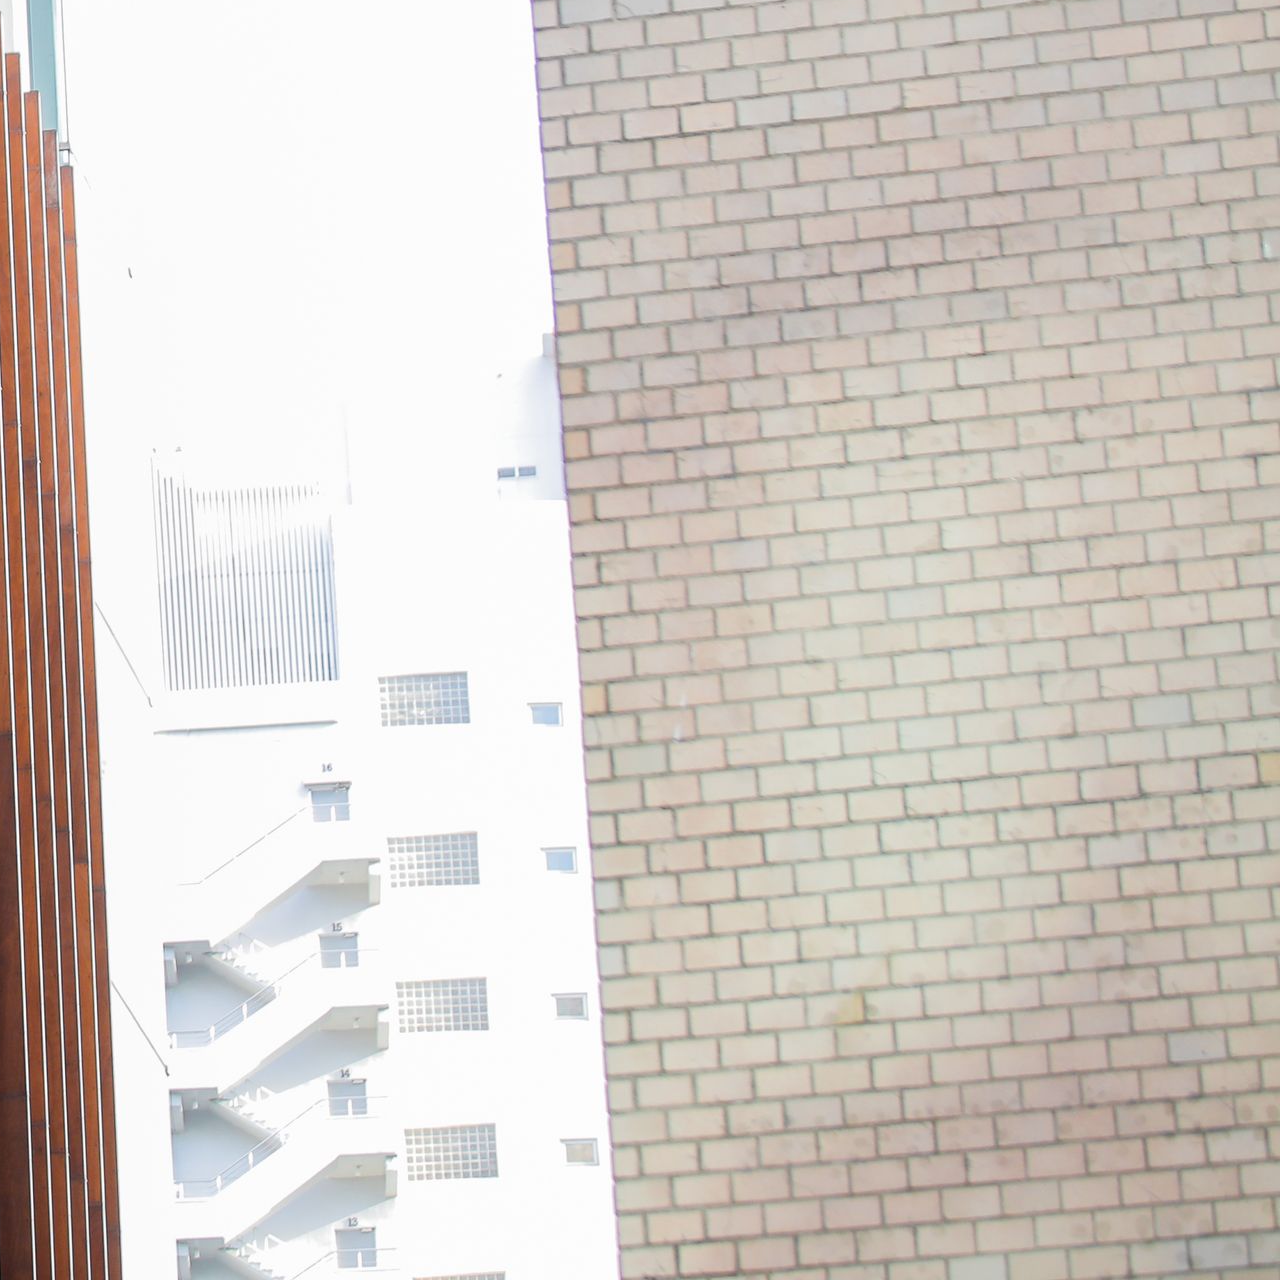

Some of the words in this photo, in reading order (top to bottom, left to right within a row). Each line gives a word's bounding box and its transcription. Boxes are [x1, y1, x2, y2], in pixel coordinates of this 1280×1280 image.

[321, 762, 333, 773] 16
[331, 921, 344, 932] 15
[340, 1068, 350, 1078] 14
[347, 1217, 359, 1227] 13
